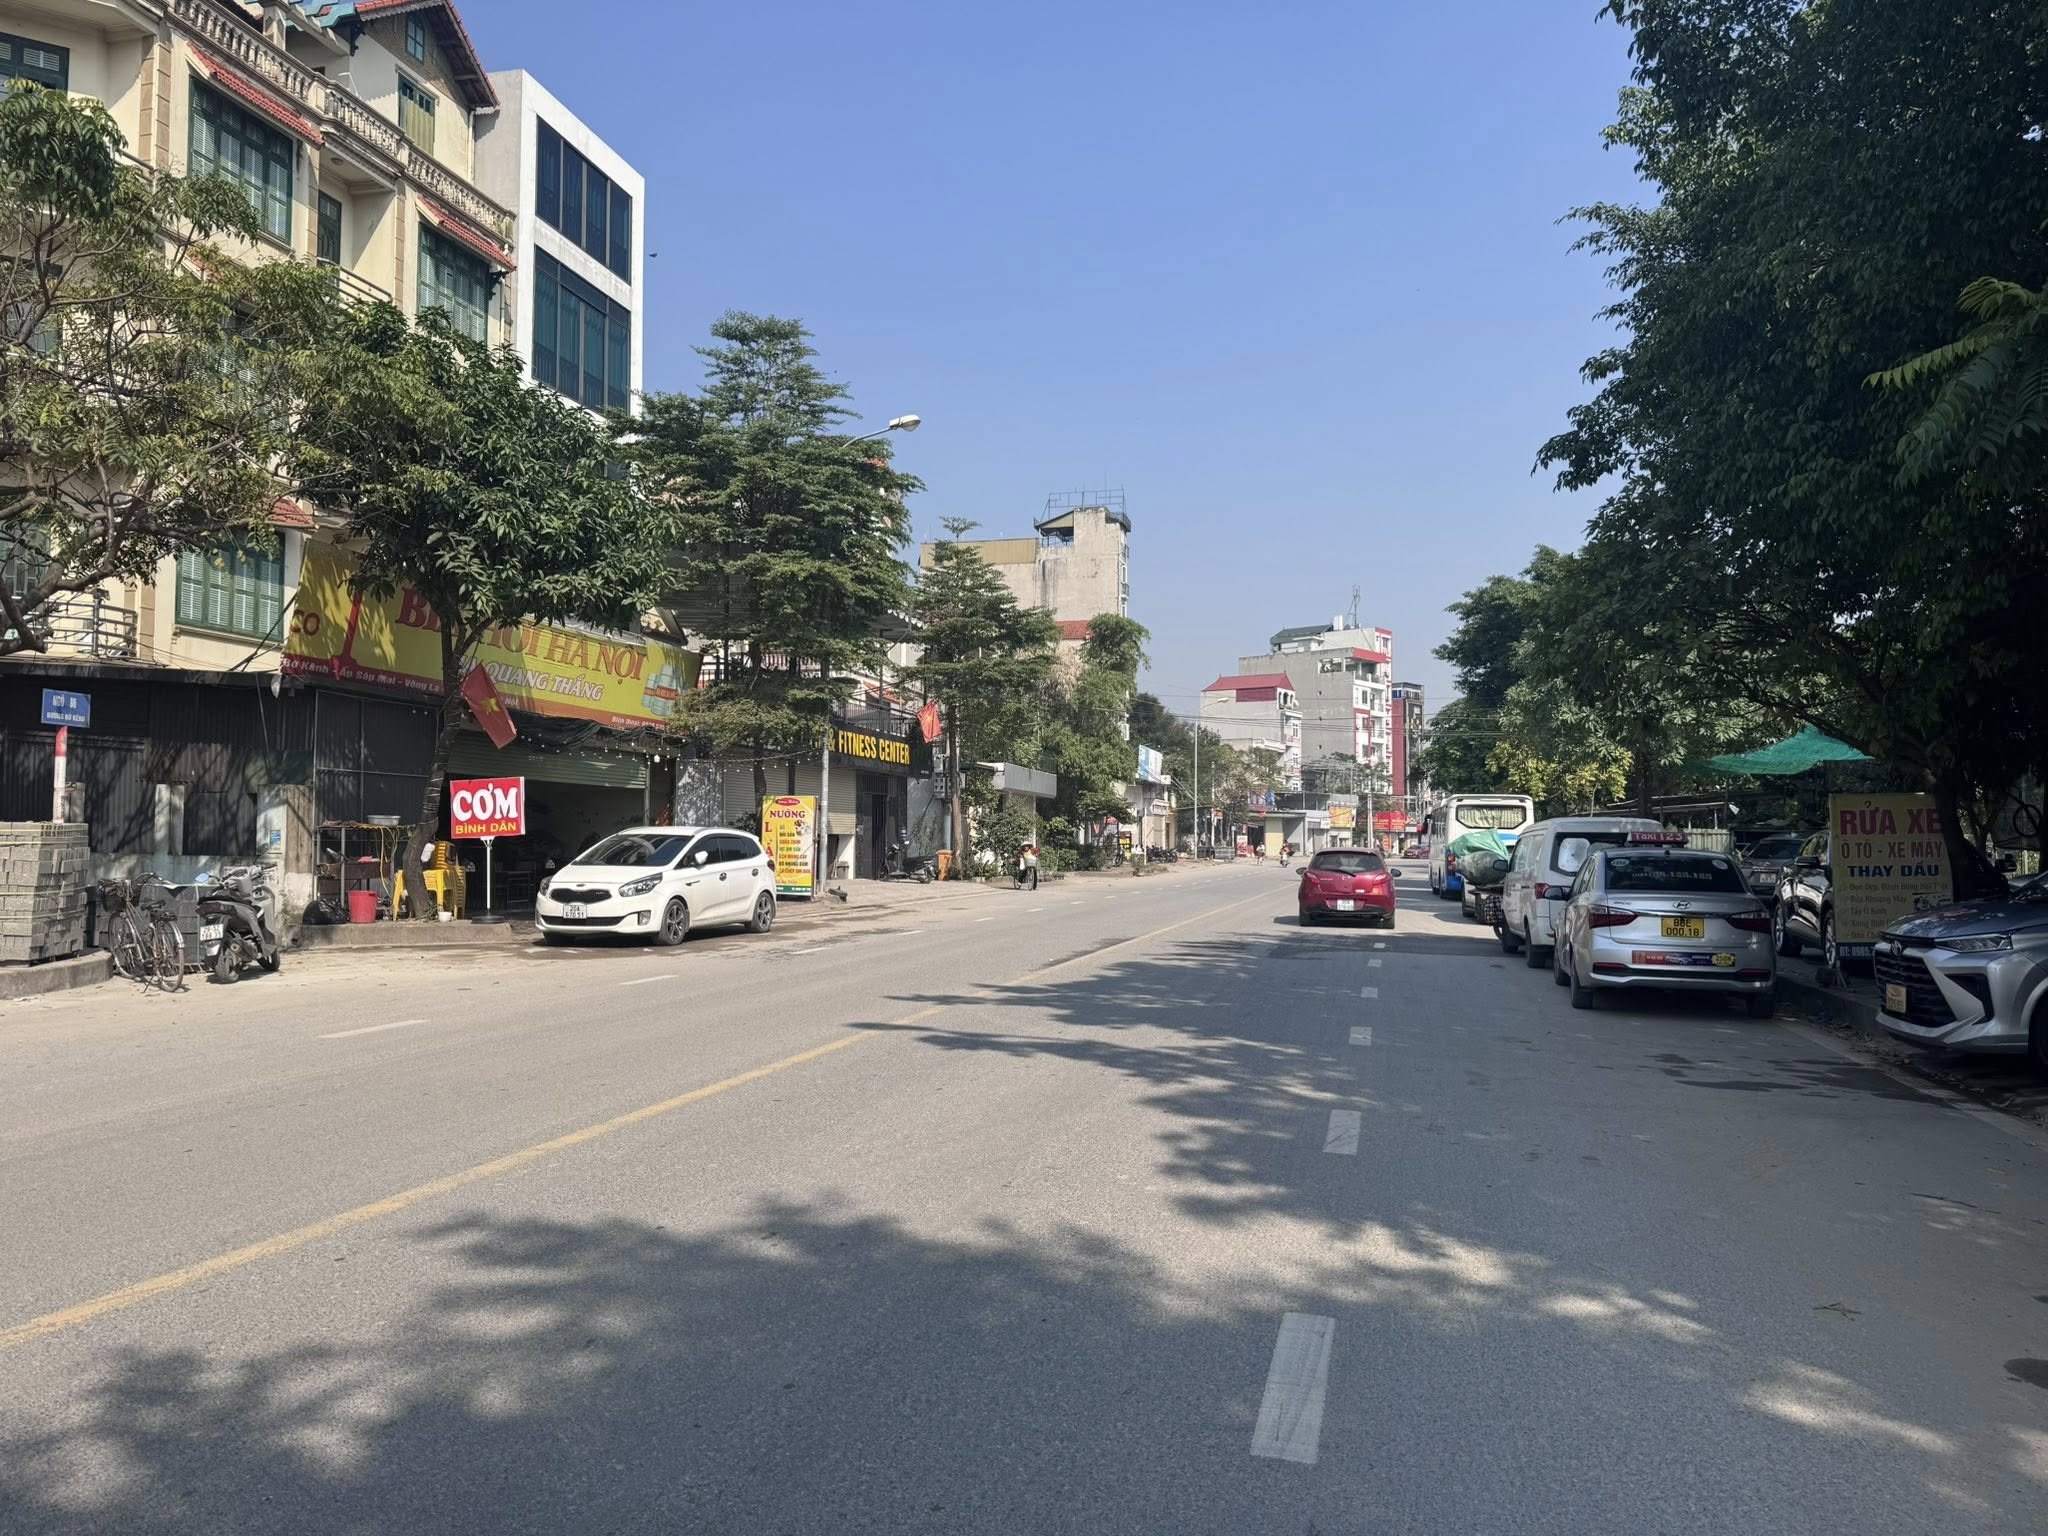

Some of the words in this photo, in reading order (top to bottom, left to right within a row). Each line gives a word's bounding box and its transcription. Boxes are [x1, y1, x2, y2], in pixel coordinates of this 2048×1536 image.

[591, 640, 648, 685] NỘI
[486, 661, 549, 690] QUANG
[551, 673, 605, 701] THẮNG
[838, 730, 877, 759] FITNESS
[879, 738, 910, 766] CENTER
[452, 782, 519, 822] CƠM
[455, 822, 486, 835] BÌNH
[490, 820, 517, 832] DÂN
[1839, 800, 1897, 836] RỬA
[1907, 808, 1942, 835] XE
[1634, 832, 1657, 842] Taxi
[1841, 839, 1850, 860] Ô
[1855, 839, 1872, 860] TÔ
[1888, 841, 1906, 859] XE
[1910, 837, 1943, 859] MÁY
[1847, 864, 1894, 878] THAY
[1666, 927, 1700, 938] 000.18
